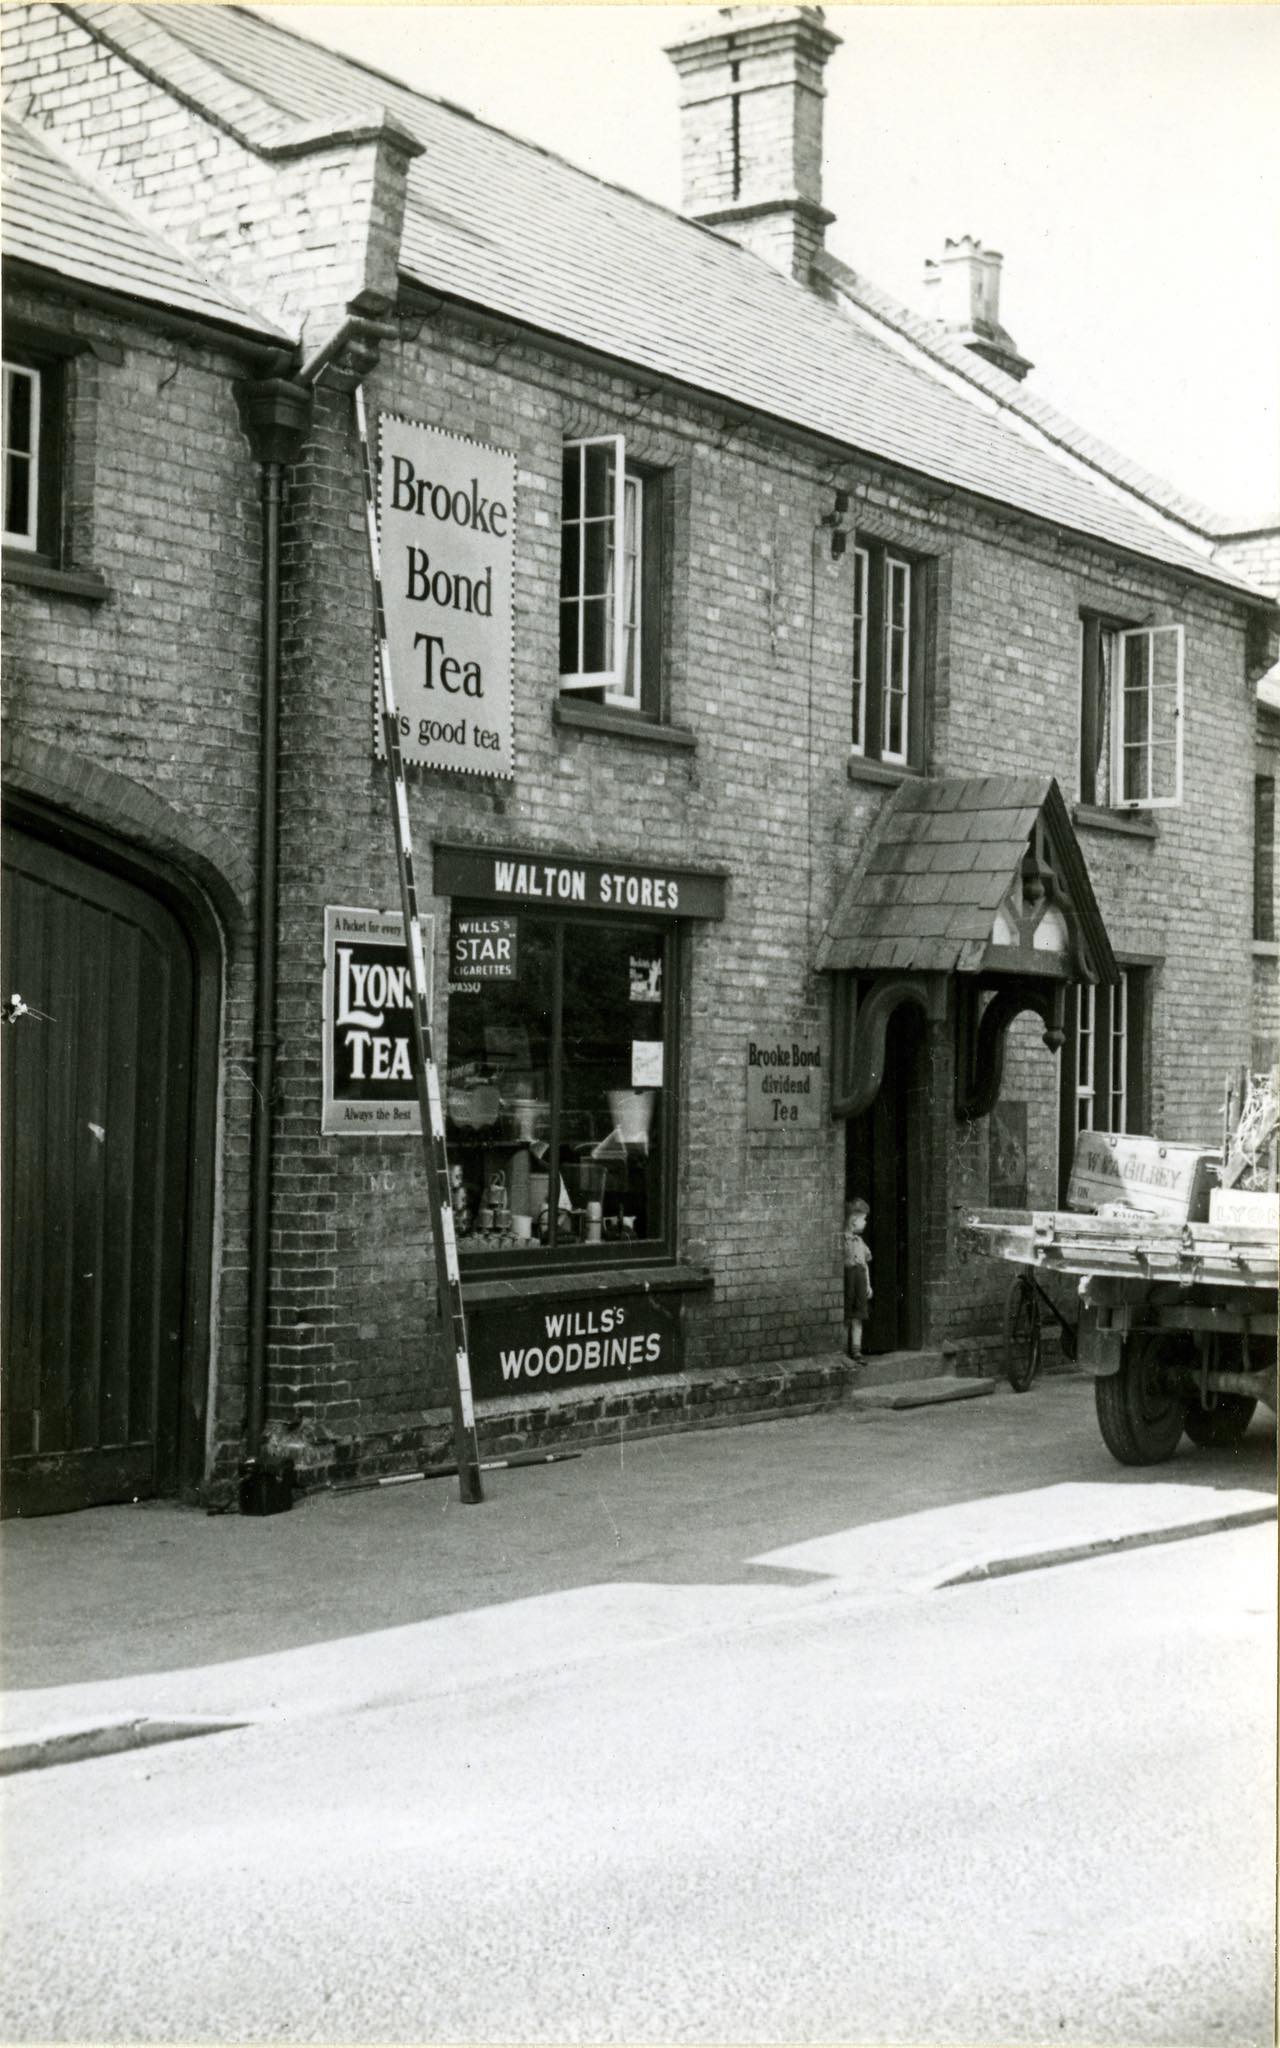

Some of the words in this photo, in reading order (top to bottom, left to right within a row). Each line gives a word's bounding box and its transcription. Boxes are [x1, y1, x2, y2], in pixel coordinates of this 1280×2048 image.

[390, 455, 507, 537] Brooke
[406, 545, 493, 617] Bond
[413, 632, 484, 698] Tea
[418, 718, 466, 746] good
[473, 725, 500, 751] tea
[495, 861, 585, 900] WALTON
[600, 874, 679, 909] STORES
[334, 917, 341, 931] A
[343, 918, 366, 932] Packet
[369, 921, 379, 933] for
[381, 925, 401, 937] every
[454, 964, 511, 976] CIGARETTES
[345, 1031, 413, 1080] TEA
[749, 1042, 790, 1068] Brooke
[791, 1043, 821, 1068] Bond
[761, 1075, 810, 1094] dividend
[344, 1107, 374, 1126] Always
[377, 1108, 390, 1120] the
[393, 1108, 411, 1120] Best
[771, 1099, 798, 1121] Tea
[500, 1333, 661, 1380] WOODBINES
